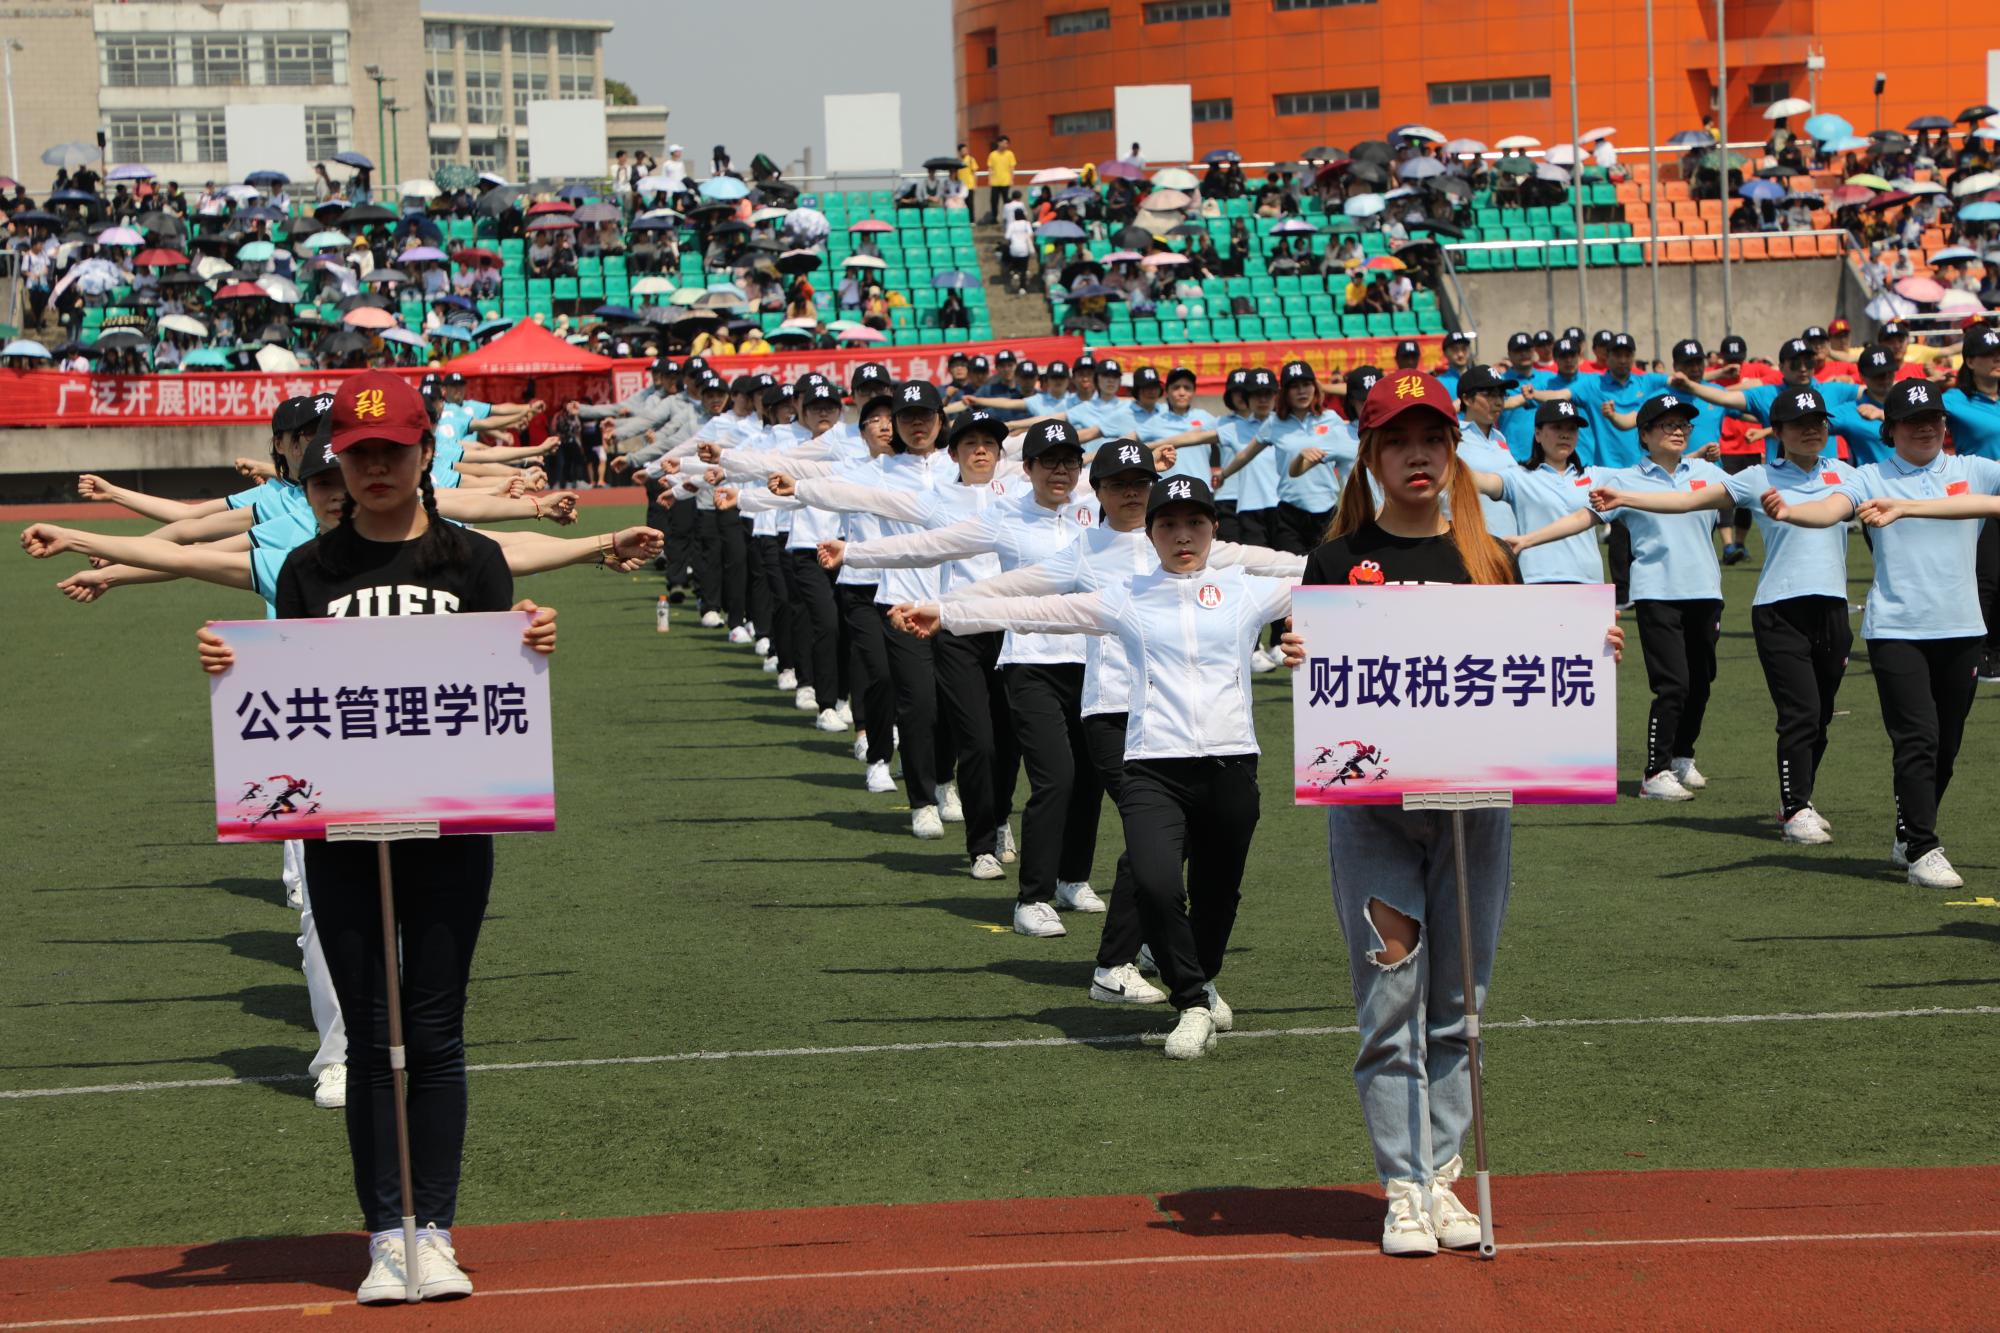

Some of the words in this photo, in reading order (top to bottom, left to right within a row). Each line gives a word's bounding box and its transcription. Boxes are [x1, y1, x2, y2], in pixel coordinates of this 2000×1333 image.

[1309, 654, 1596, 709] 财政税务学院
[236, 682, 529, 741] 公共管理学院
